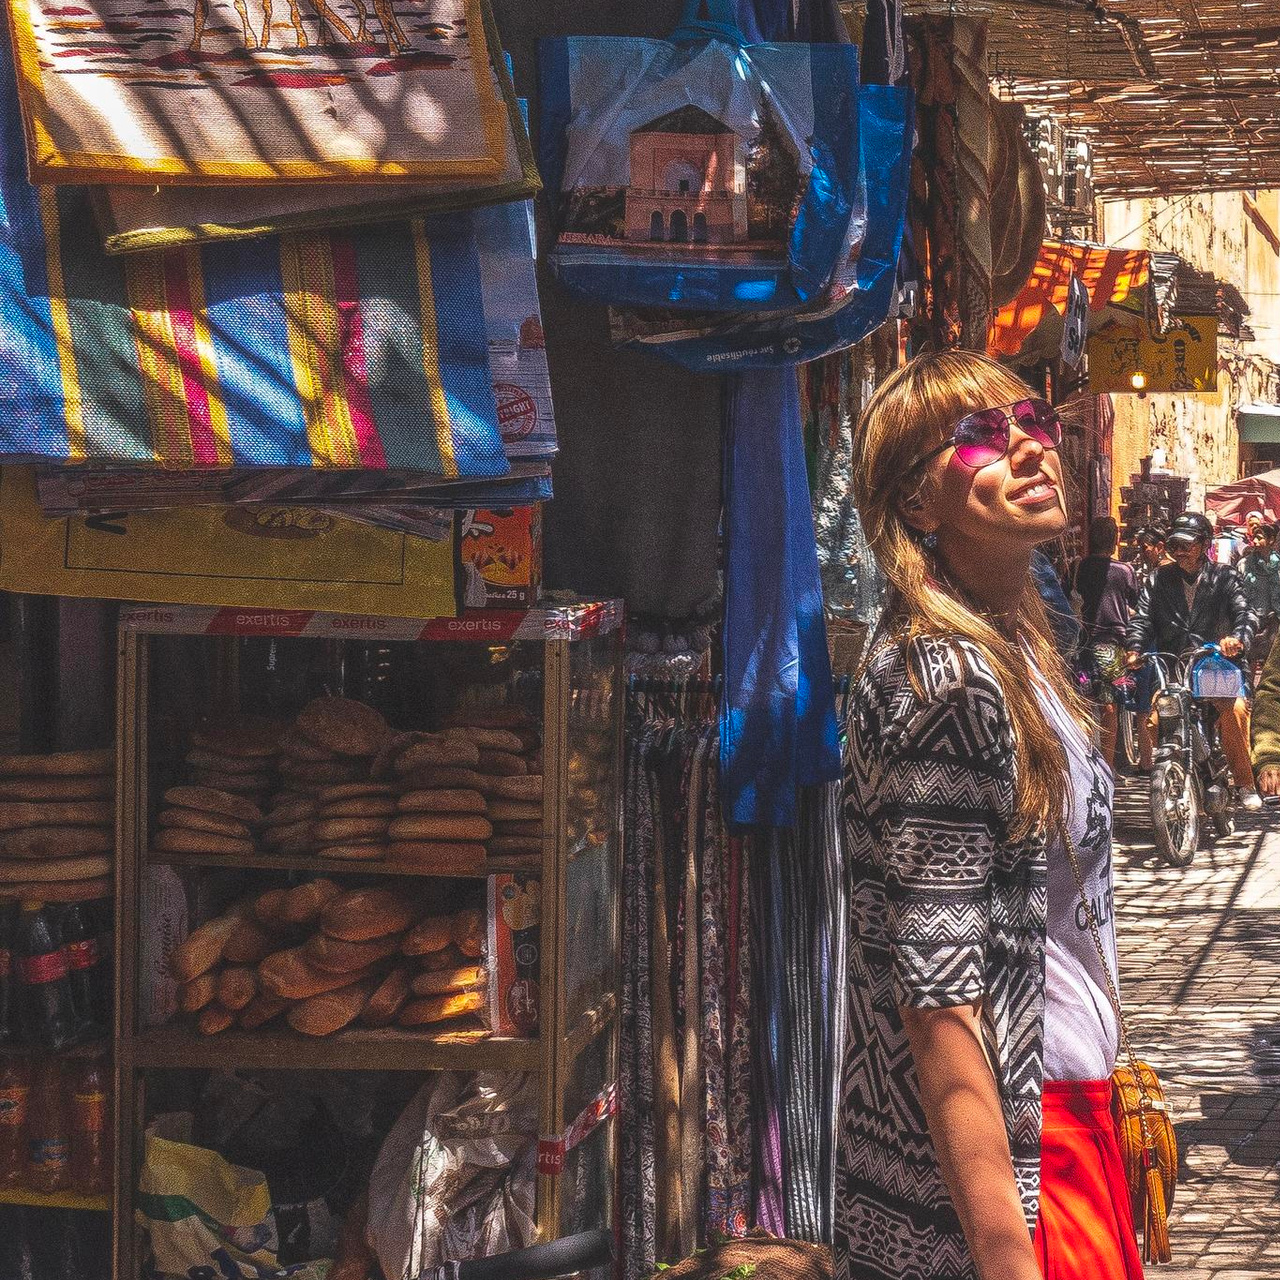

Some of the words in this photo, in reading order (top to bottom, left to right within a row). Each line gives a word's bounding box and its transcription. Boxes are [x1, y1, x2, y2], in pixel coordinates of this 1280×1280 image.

[506, 590, 517, 599] 25
[236, 612, 290, 628] exertis
[331, 617, 386, 632] exertis
[448, 618, 501, 632] exertis
[539, 1151, 561, 1165] rtis
